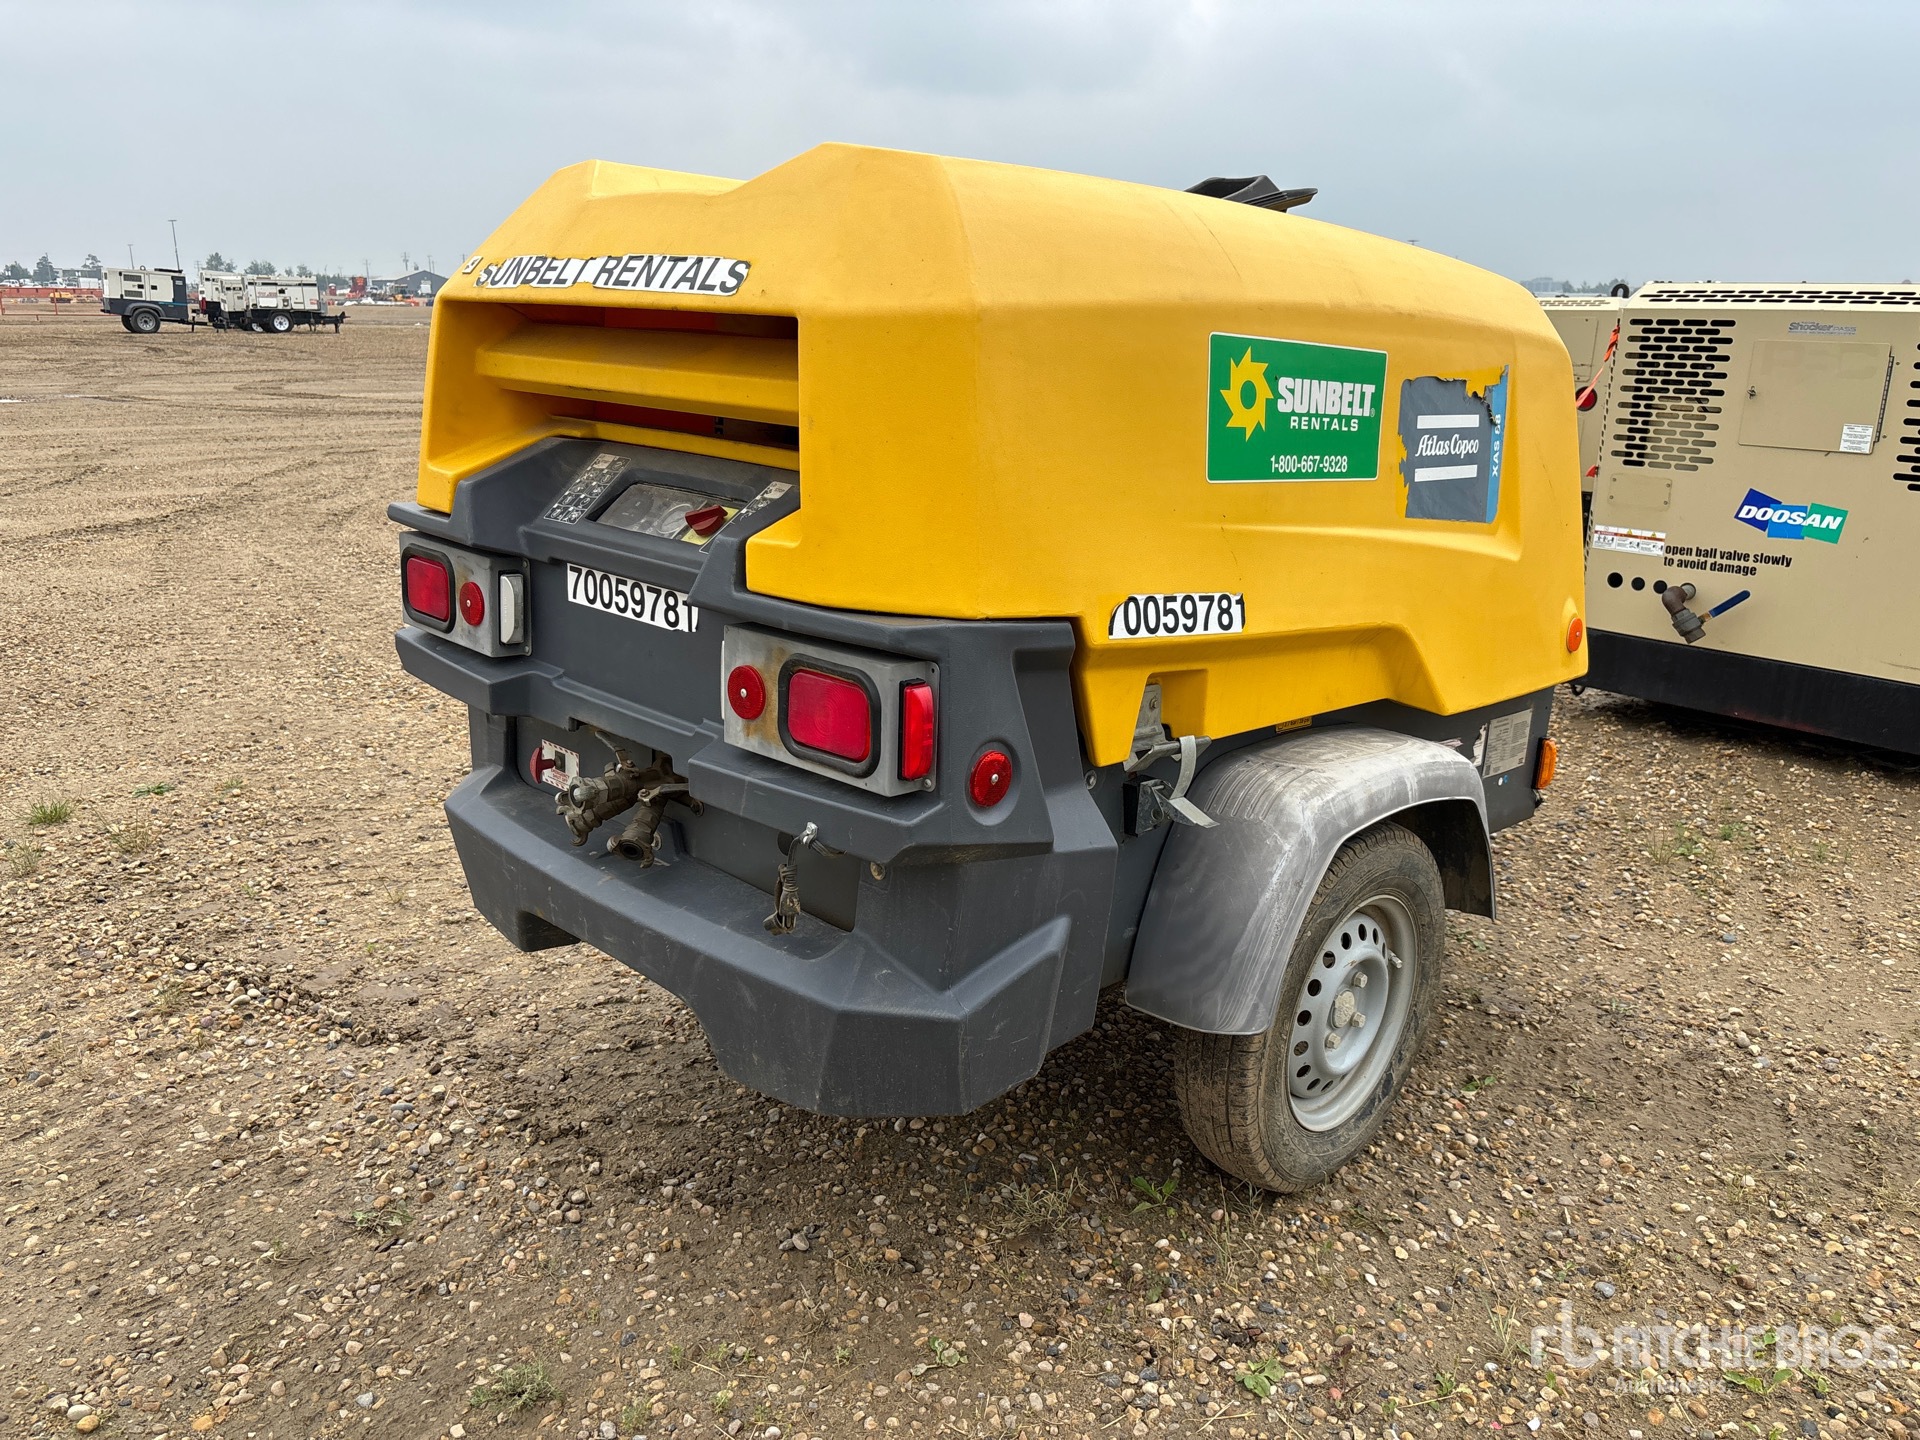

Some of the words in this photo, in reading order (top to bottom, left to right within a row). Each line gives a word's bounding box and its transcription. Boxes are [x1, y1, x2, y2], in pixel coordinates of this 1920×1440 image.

[593, 254, 752, 294] RENTALS
[1277, 376, 1376, 417] SUNBELT
[1290, 416, 1359, 431] RENTALS
[1415, 434, 1450, 457] Atlas
[1450, 433, 1479, 459] Copco
[1492, 440, 1500, 477] XAS
[1270, 454, 1348, 473] 1-800-667-9328
[1738, 505, 1843, 530] DOOSAN
[1664, 556, 1674, 567] to
[1677, 558, 1708, 571] avoid
[1710, 561, 1757, 577] damage
[1665, 545, 1693, 557] open
[1695, 547, 1718, 559] ball
[1719, 550, 1750, 562] valve
[1753, 552, 1793, 568] slowly
[568, 566, 693, 633] 70059781
